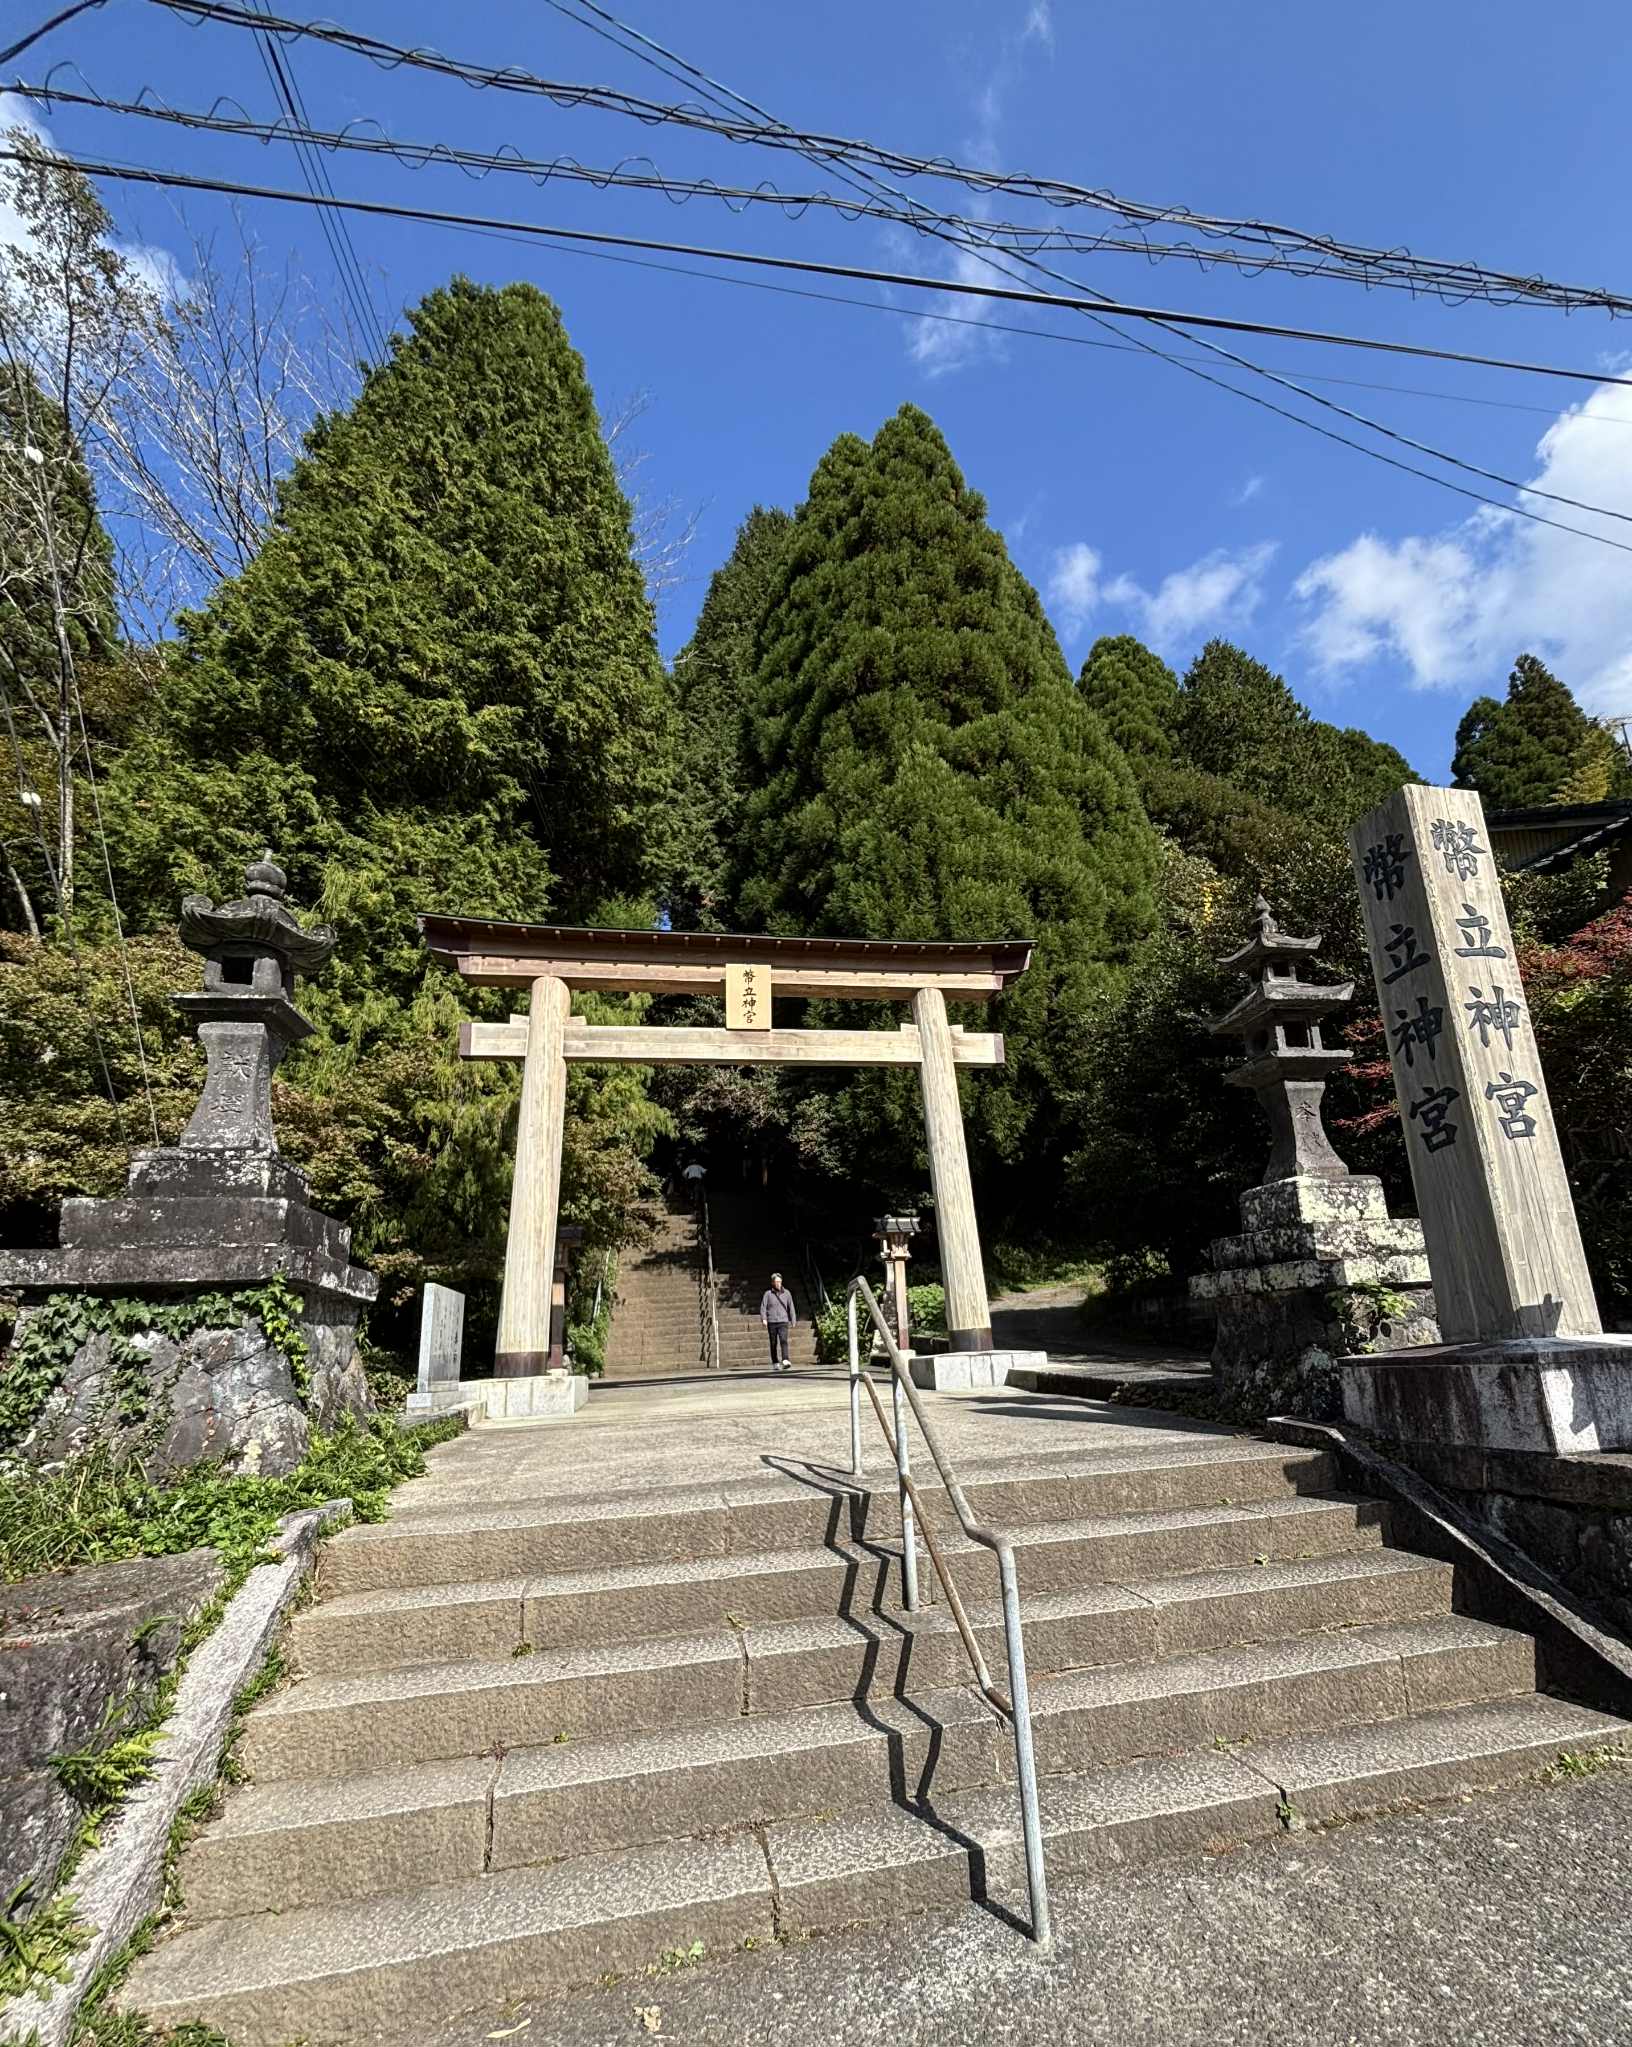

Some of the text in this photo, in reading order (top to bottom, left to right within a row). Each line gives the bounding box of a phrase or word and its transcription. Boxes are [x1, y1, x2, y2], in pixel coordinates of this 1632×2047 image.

[741, 968, 757, 1024] 幣立神宮
[1363, 833, 1460, 1153] 幣立神宮
[1431, 818, 1537, 1140] 幣立神宮
